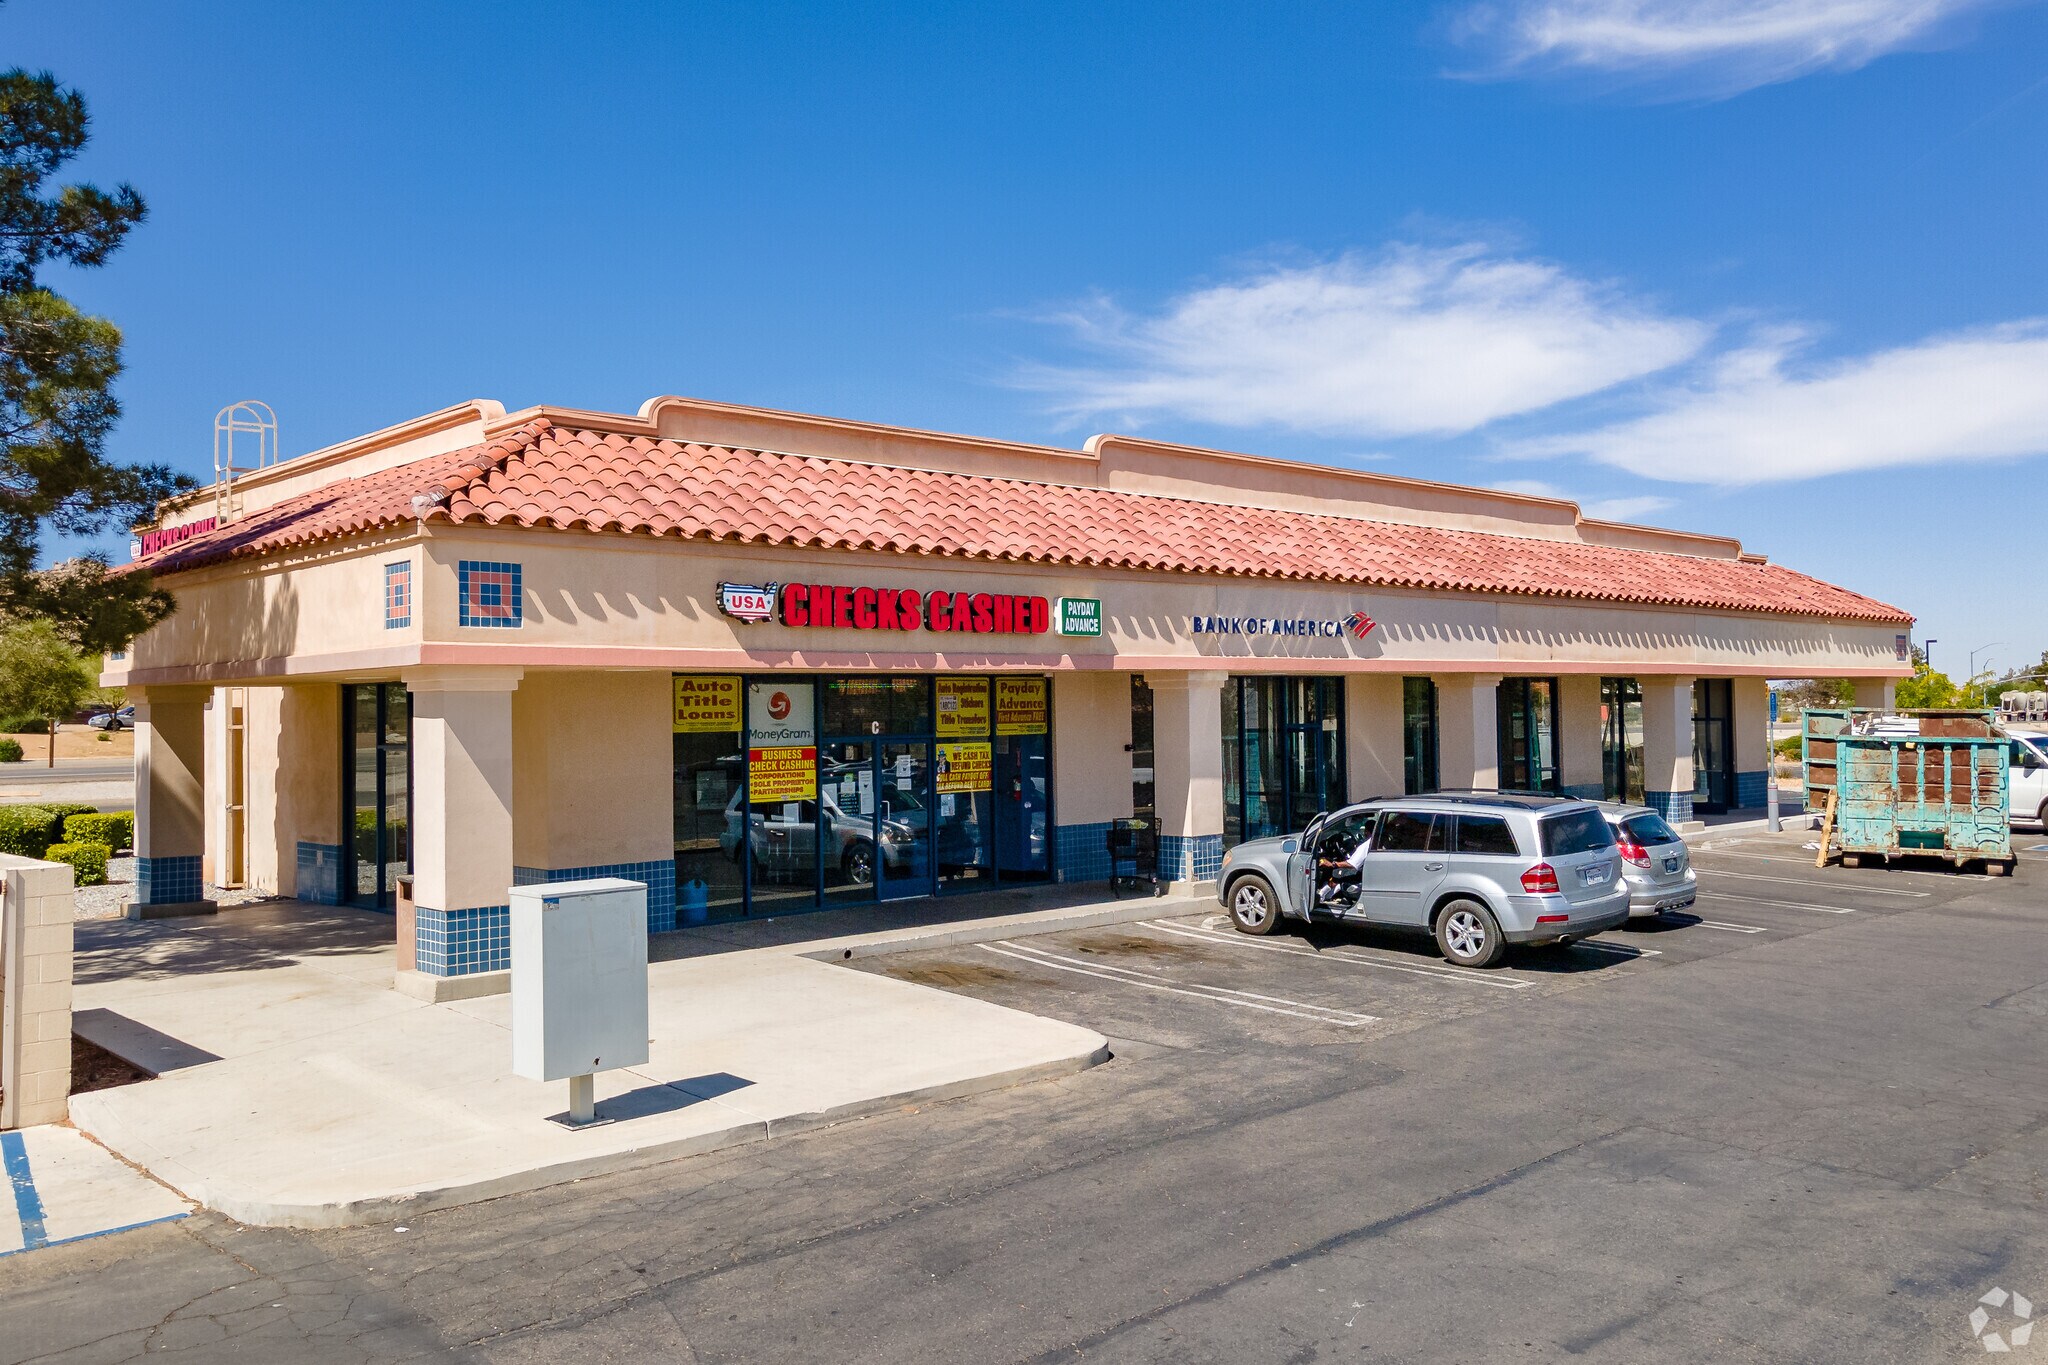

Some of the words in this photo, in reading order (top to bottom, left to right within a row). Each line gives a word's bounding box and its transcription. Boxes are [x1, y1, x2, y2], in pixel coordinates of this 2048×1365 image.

[142, 527, 180, 556] CHECKS
[731, 595, 766, 609] USA
[782, 582, 921, 631] CHECKS
[928, 590, 1049, 634] CASHED
[1067, 601, 1096, 616] PAYDAY
[1065, 617, 1099, 632] ADVANCE
[1193, 616, 1241, 634] BANK
[1246, 618, 1267, 634] OF
[1270, 619, 1344, 637] AMERICA
[681, 680, 733, 692] Auto
[1000, 682, 1041, 695] Payday
[680, 695, 732, 707] Title
[999, 697, 1044, 709] Advance
[678, 709, 736, 720] Loans
[871, 721, 880, 734] C
[749, 728, 811, 741] MoneyGram
[762, 750, 802, 760] BUSINESS
[953, 752, 962, 760] WE
[963, 751, 978, 760] CASH
[979, 751, 990, 759] TAX
[749, 761, 778, 771] CHECK
[780, 759, 815, 770] CASHING
[952, 761, 971, 770] REFUND
[972, 761, 992, 769] CHECKS
[753, 772, 805, 780] CORPORATIONS
[773, 779, 815, 787] PROPRIETOR
[753, 787, 804, 795] PARTNERSHIPS
